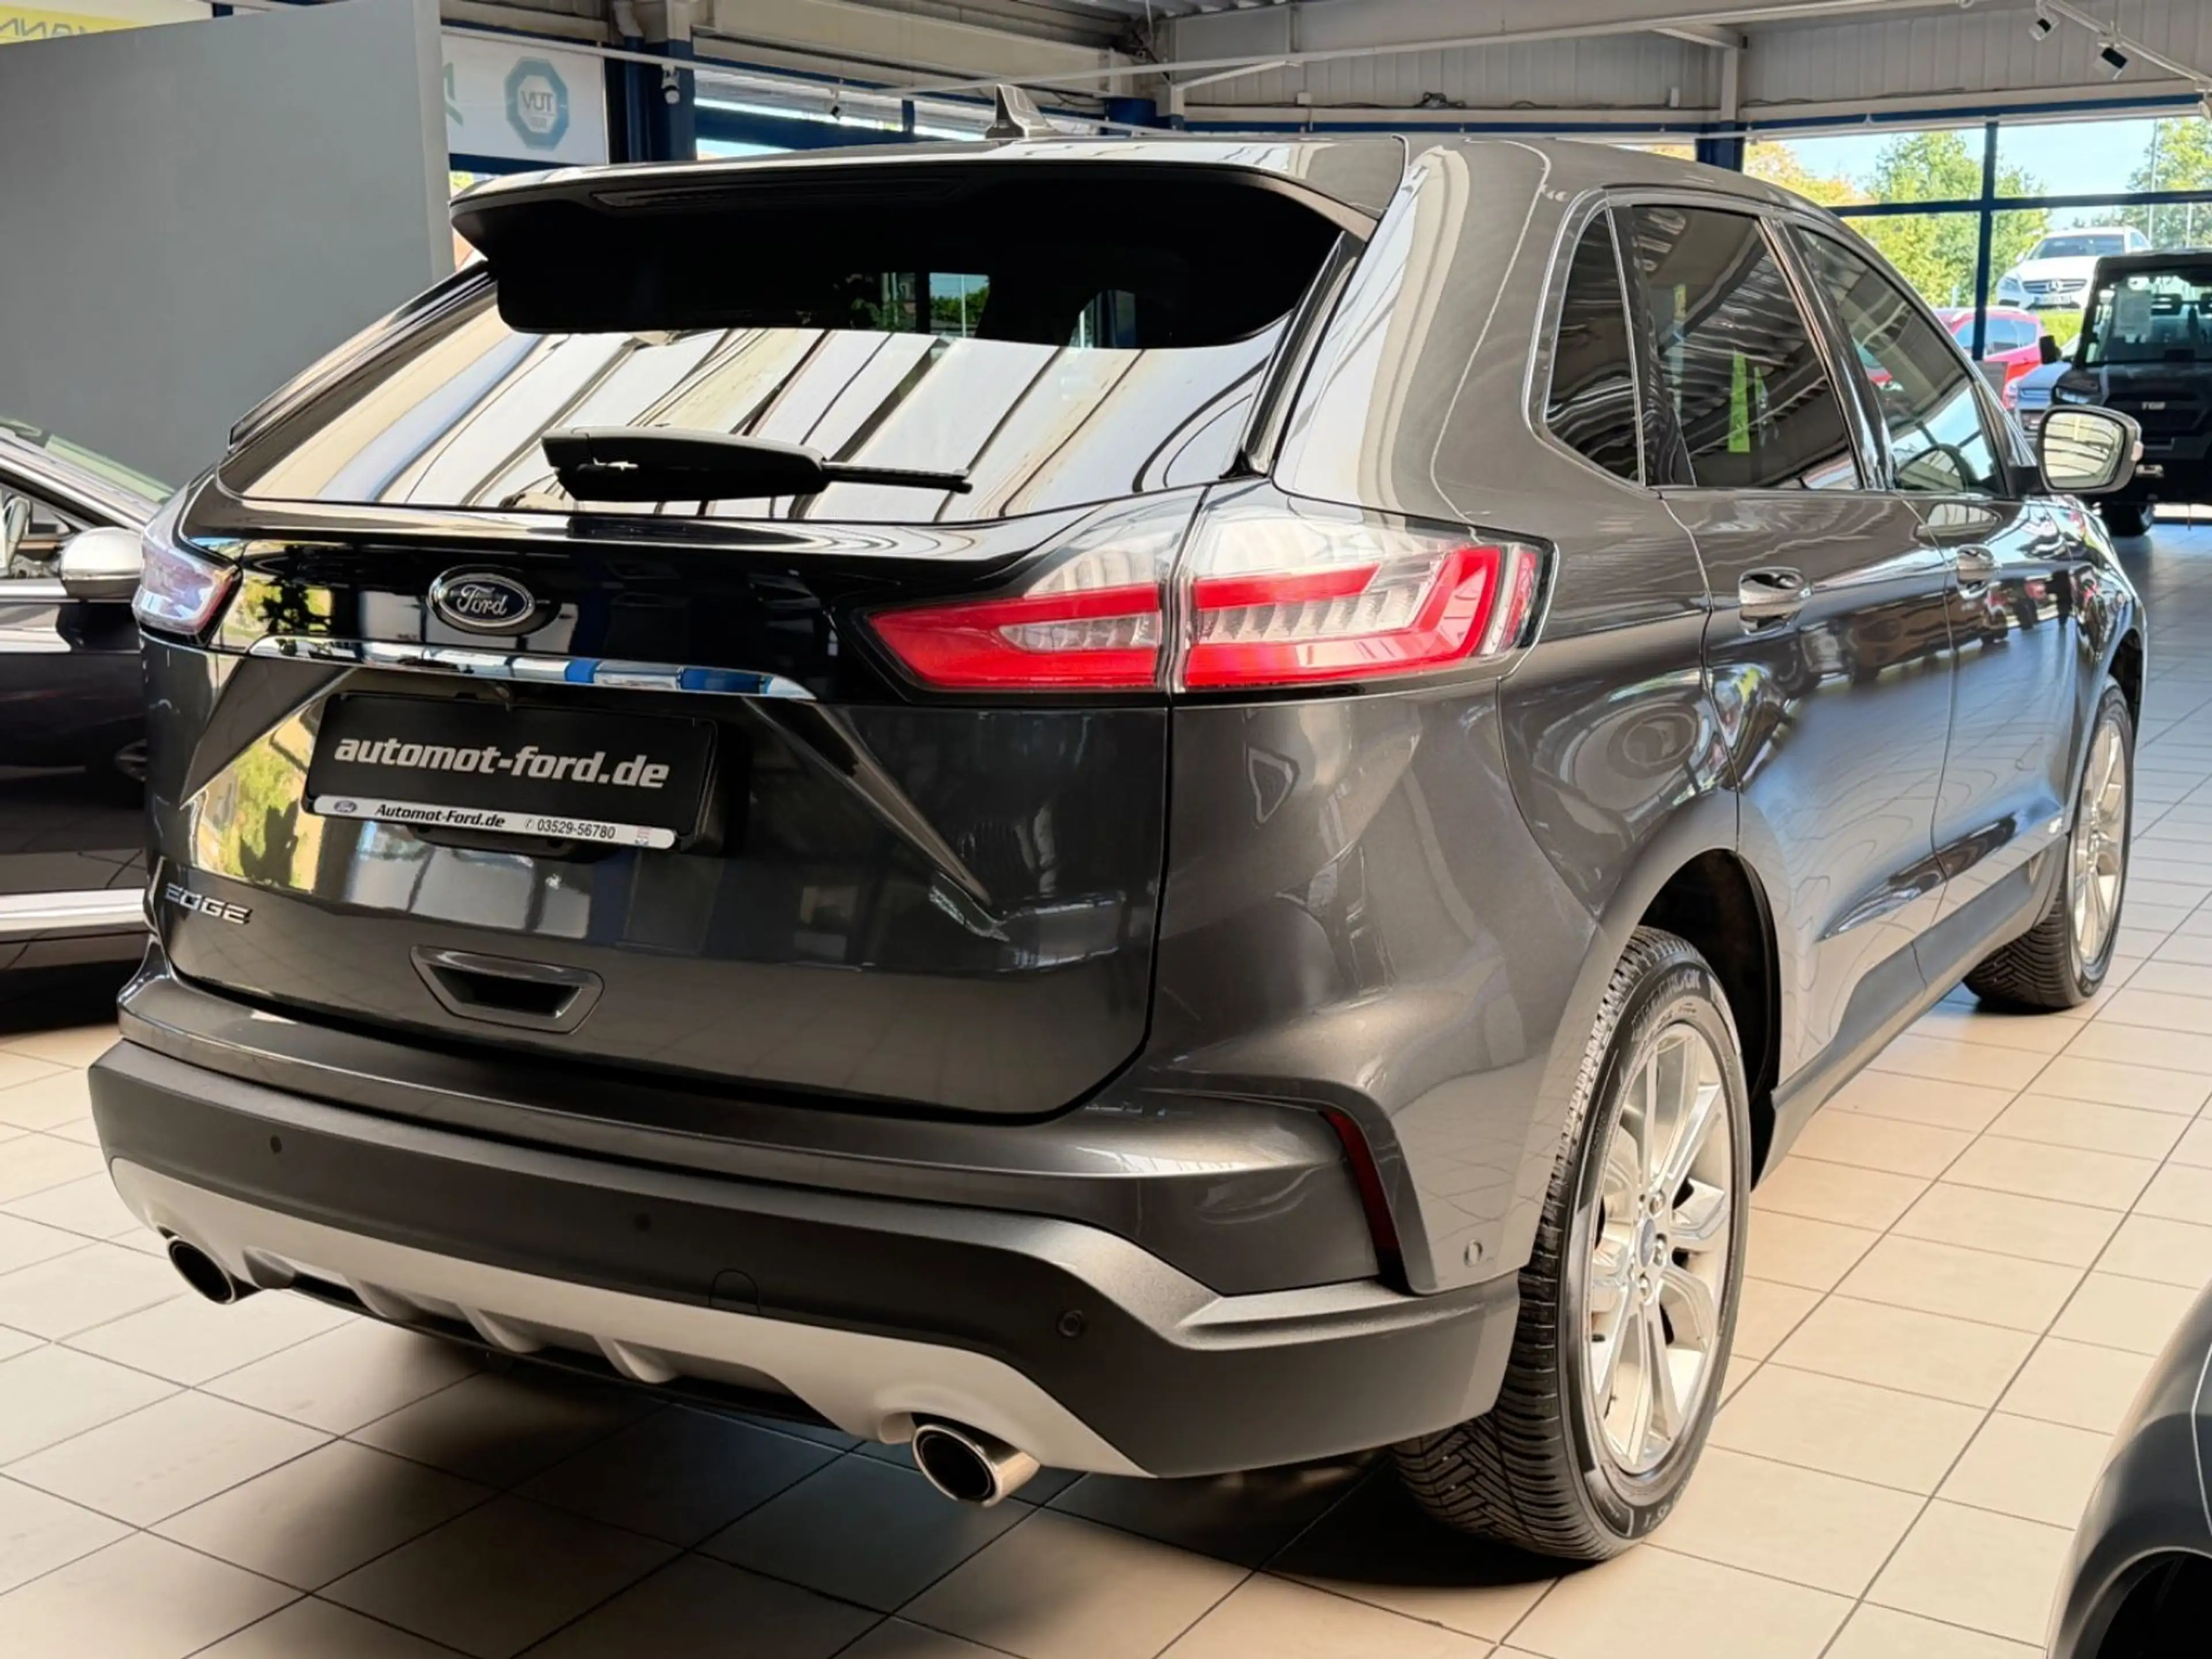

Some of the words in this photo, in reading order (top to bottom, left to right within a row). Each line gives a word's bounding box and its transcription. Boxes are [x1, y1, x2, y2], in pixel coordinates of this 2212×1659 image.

[456, 584, 509, 616] Ford
[334, 737, 670, 789] automot-ford.de
[375, 804, 505, 828] Automot-Ford.de
[537, 818, 616, 839] 03529-56780
[164, 882, 252, 925] EDGE
